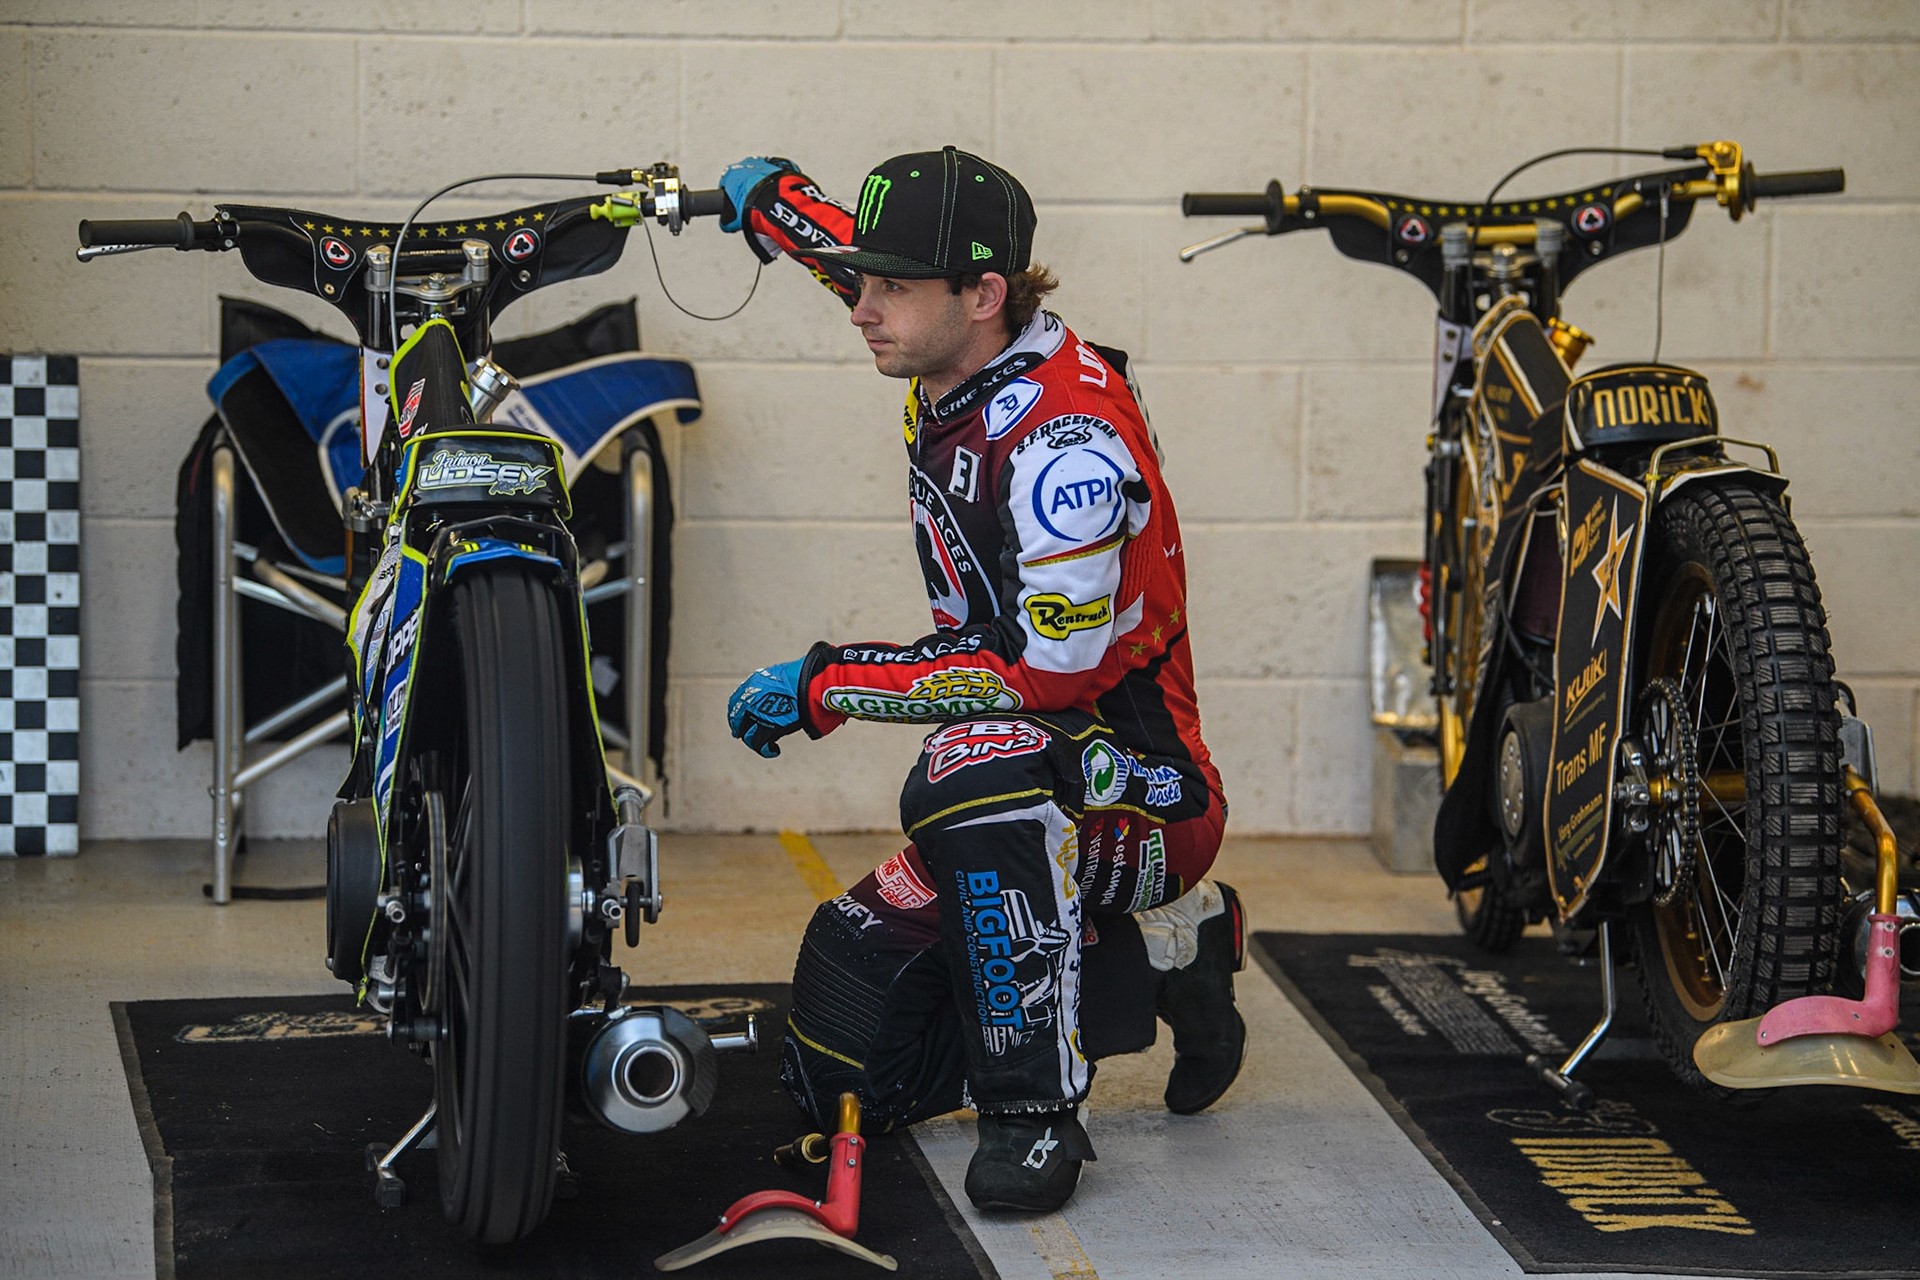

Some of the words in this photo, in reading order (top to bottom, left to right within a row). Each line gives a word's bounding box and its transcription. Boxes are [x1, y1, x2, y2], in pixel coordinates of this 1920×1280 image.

[419, 463, 550, 488] LIDSEY
[1050, 476, 1113, 515] ATPI
[936, 513, 972, 574] ACES
[1030, 601, 1108, 631] Rentruck
[838, 695, 1006, 717] AGROMIX
[1556, 748, 1587, 795] Trans
[1588, 721, 1607, 767] MF
[955, 870, 967, 902] CIVIL
[1100, 843, 1127, 906] estampa
[961, 904, 975, 933] AND
[967, 870, 1024, 1030] BIGFOOT
[966, 934, 989, 1026] CONSTRUCTION
